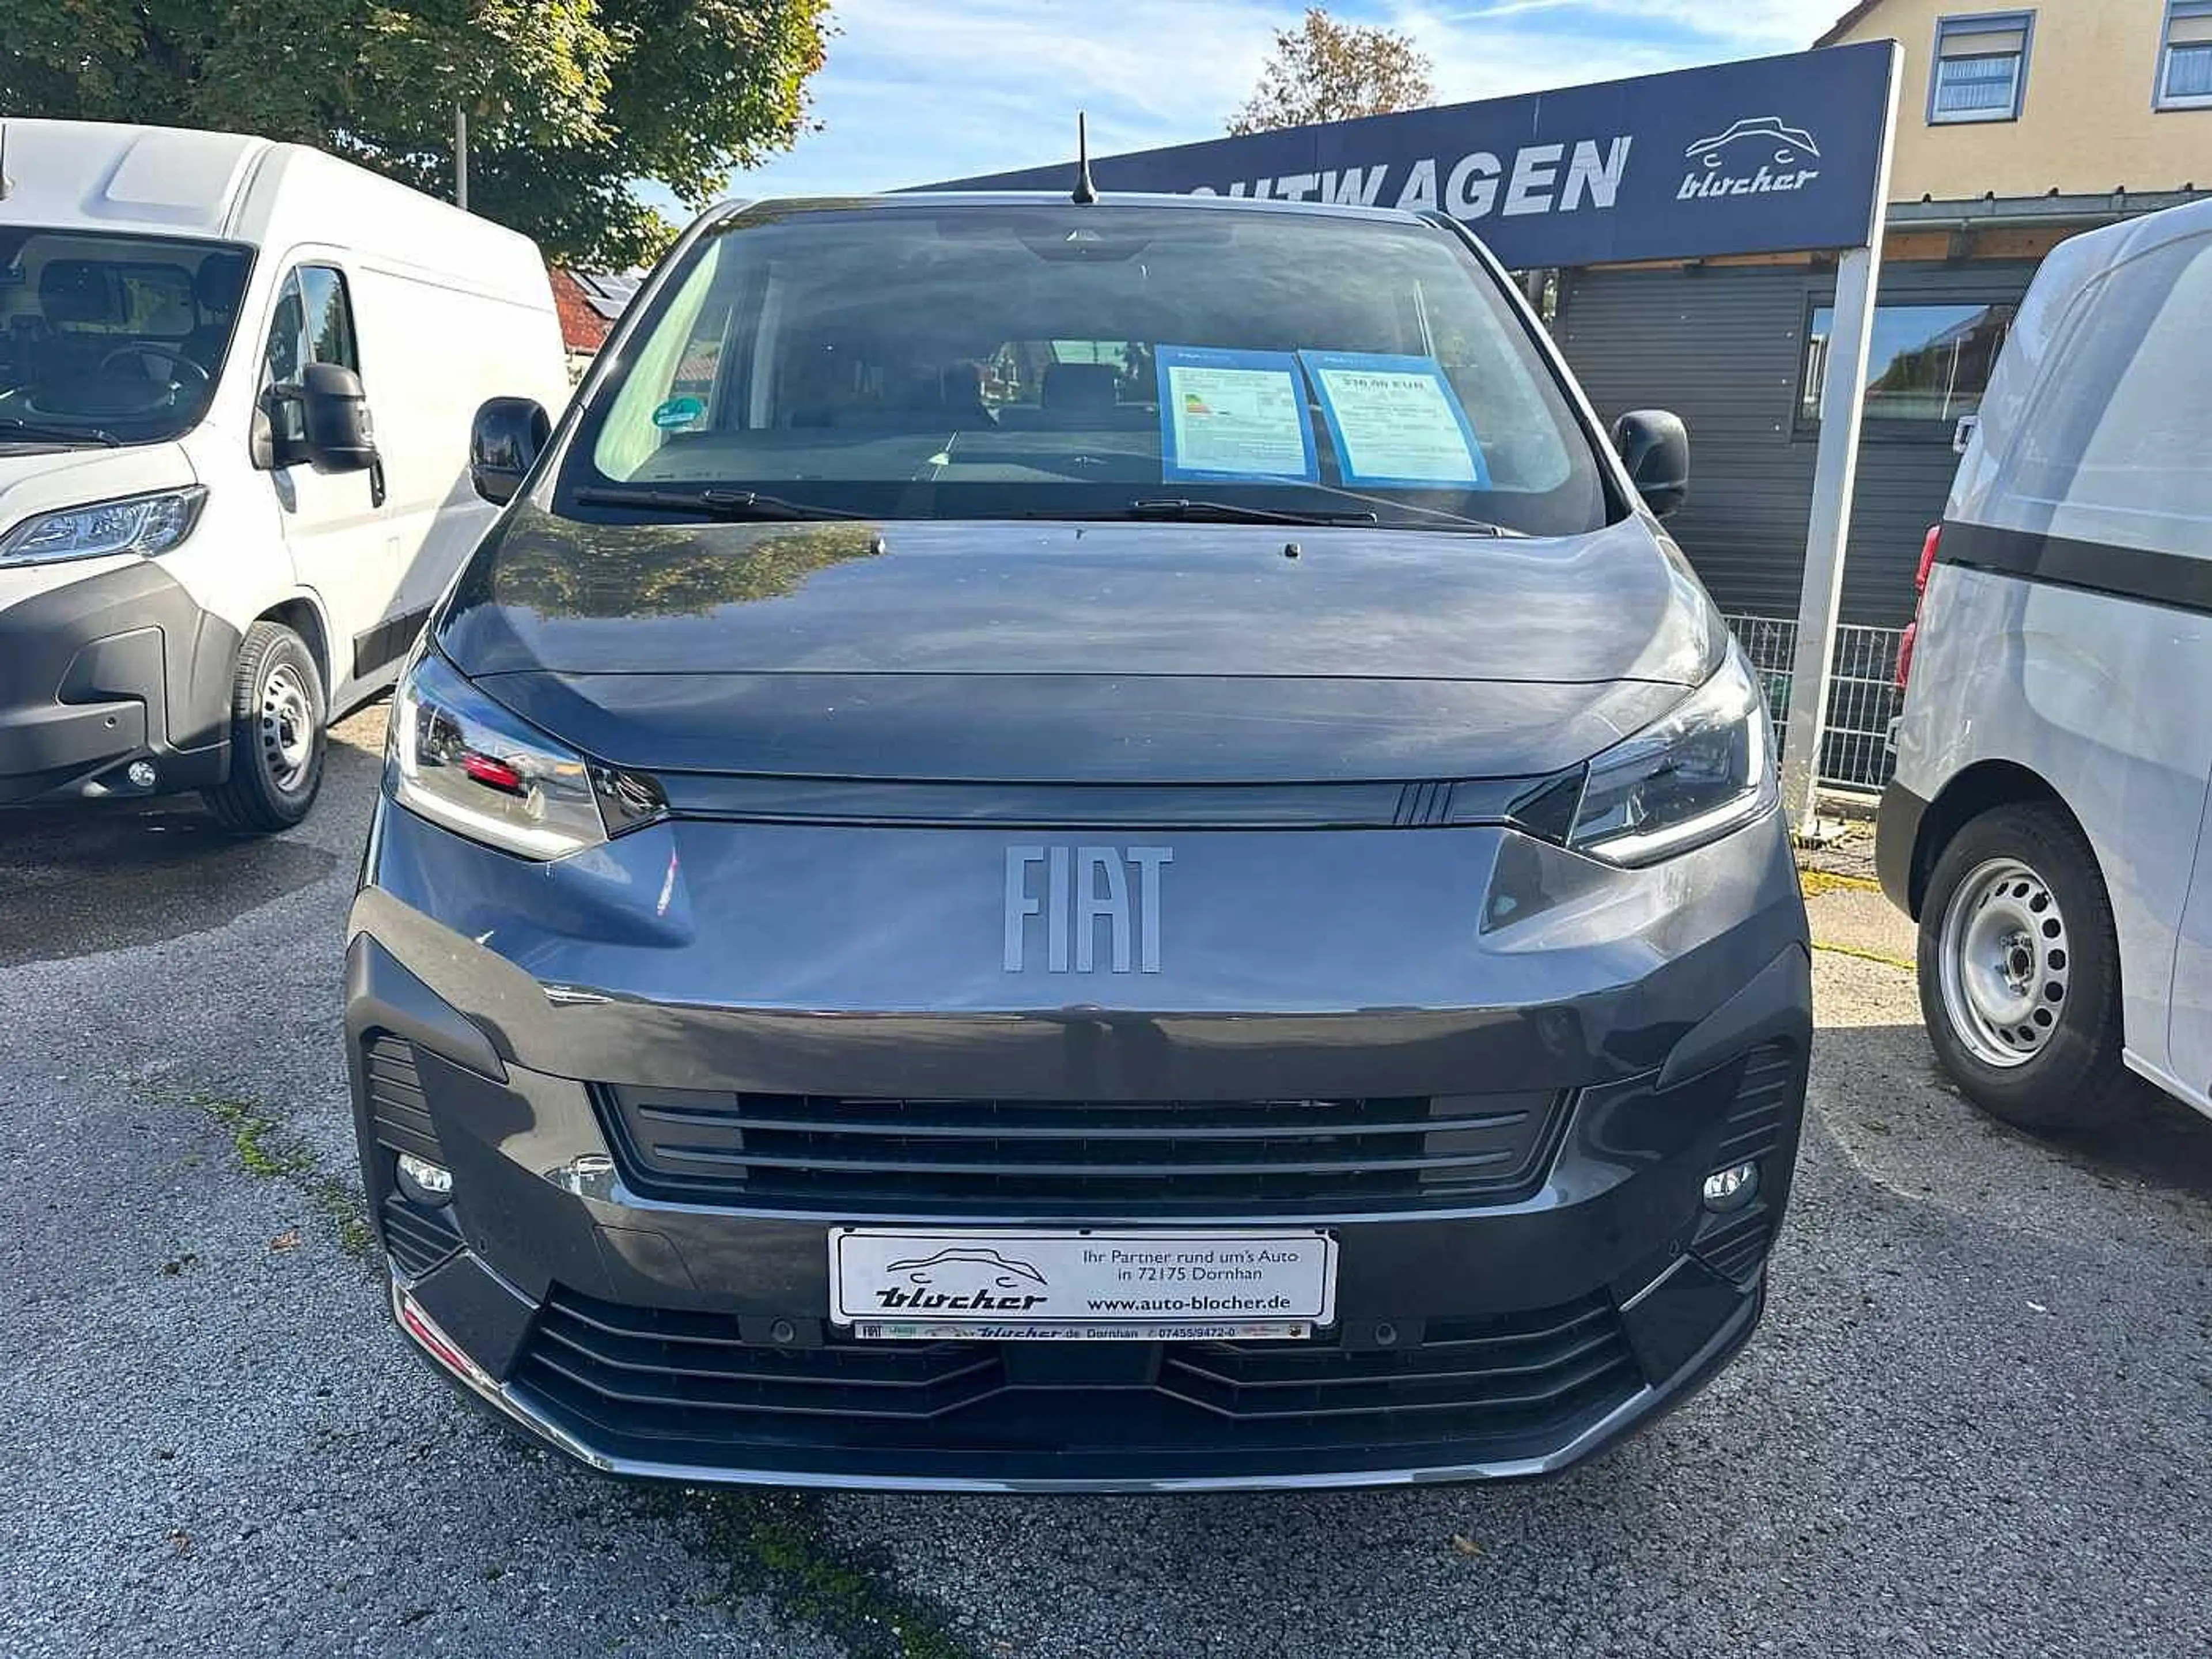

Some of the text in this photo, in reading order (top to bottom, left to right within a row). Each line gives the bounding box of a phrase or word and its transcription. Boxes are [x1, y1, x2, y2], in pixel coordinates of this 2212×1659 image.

[1005, 846, 1174, 974] FIAT
[1084, 1250, 1298, 1264] Ihr Partner rund um's Auto
[1118, 1267, 1263, 1281] in 72175 Dornhan
[876, 1287, 1048, 1310] blocher
[1088, 1295, 1290, 1310] www.auto-blocher.de
